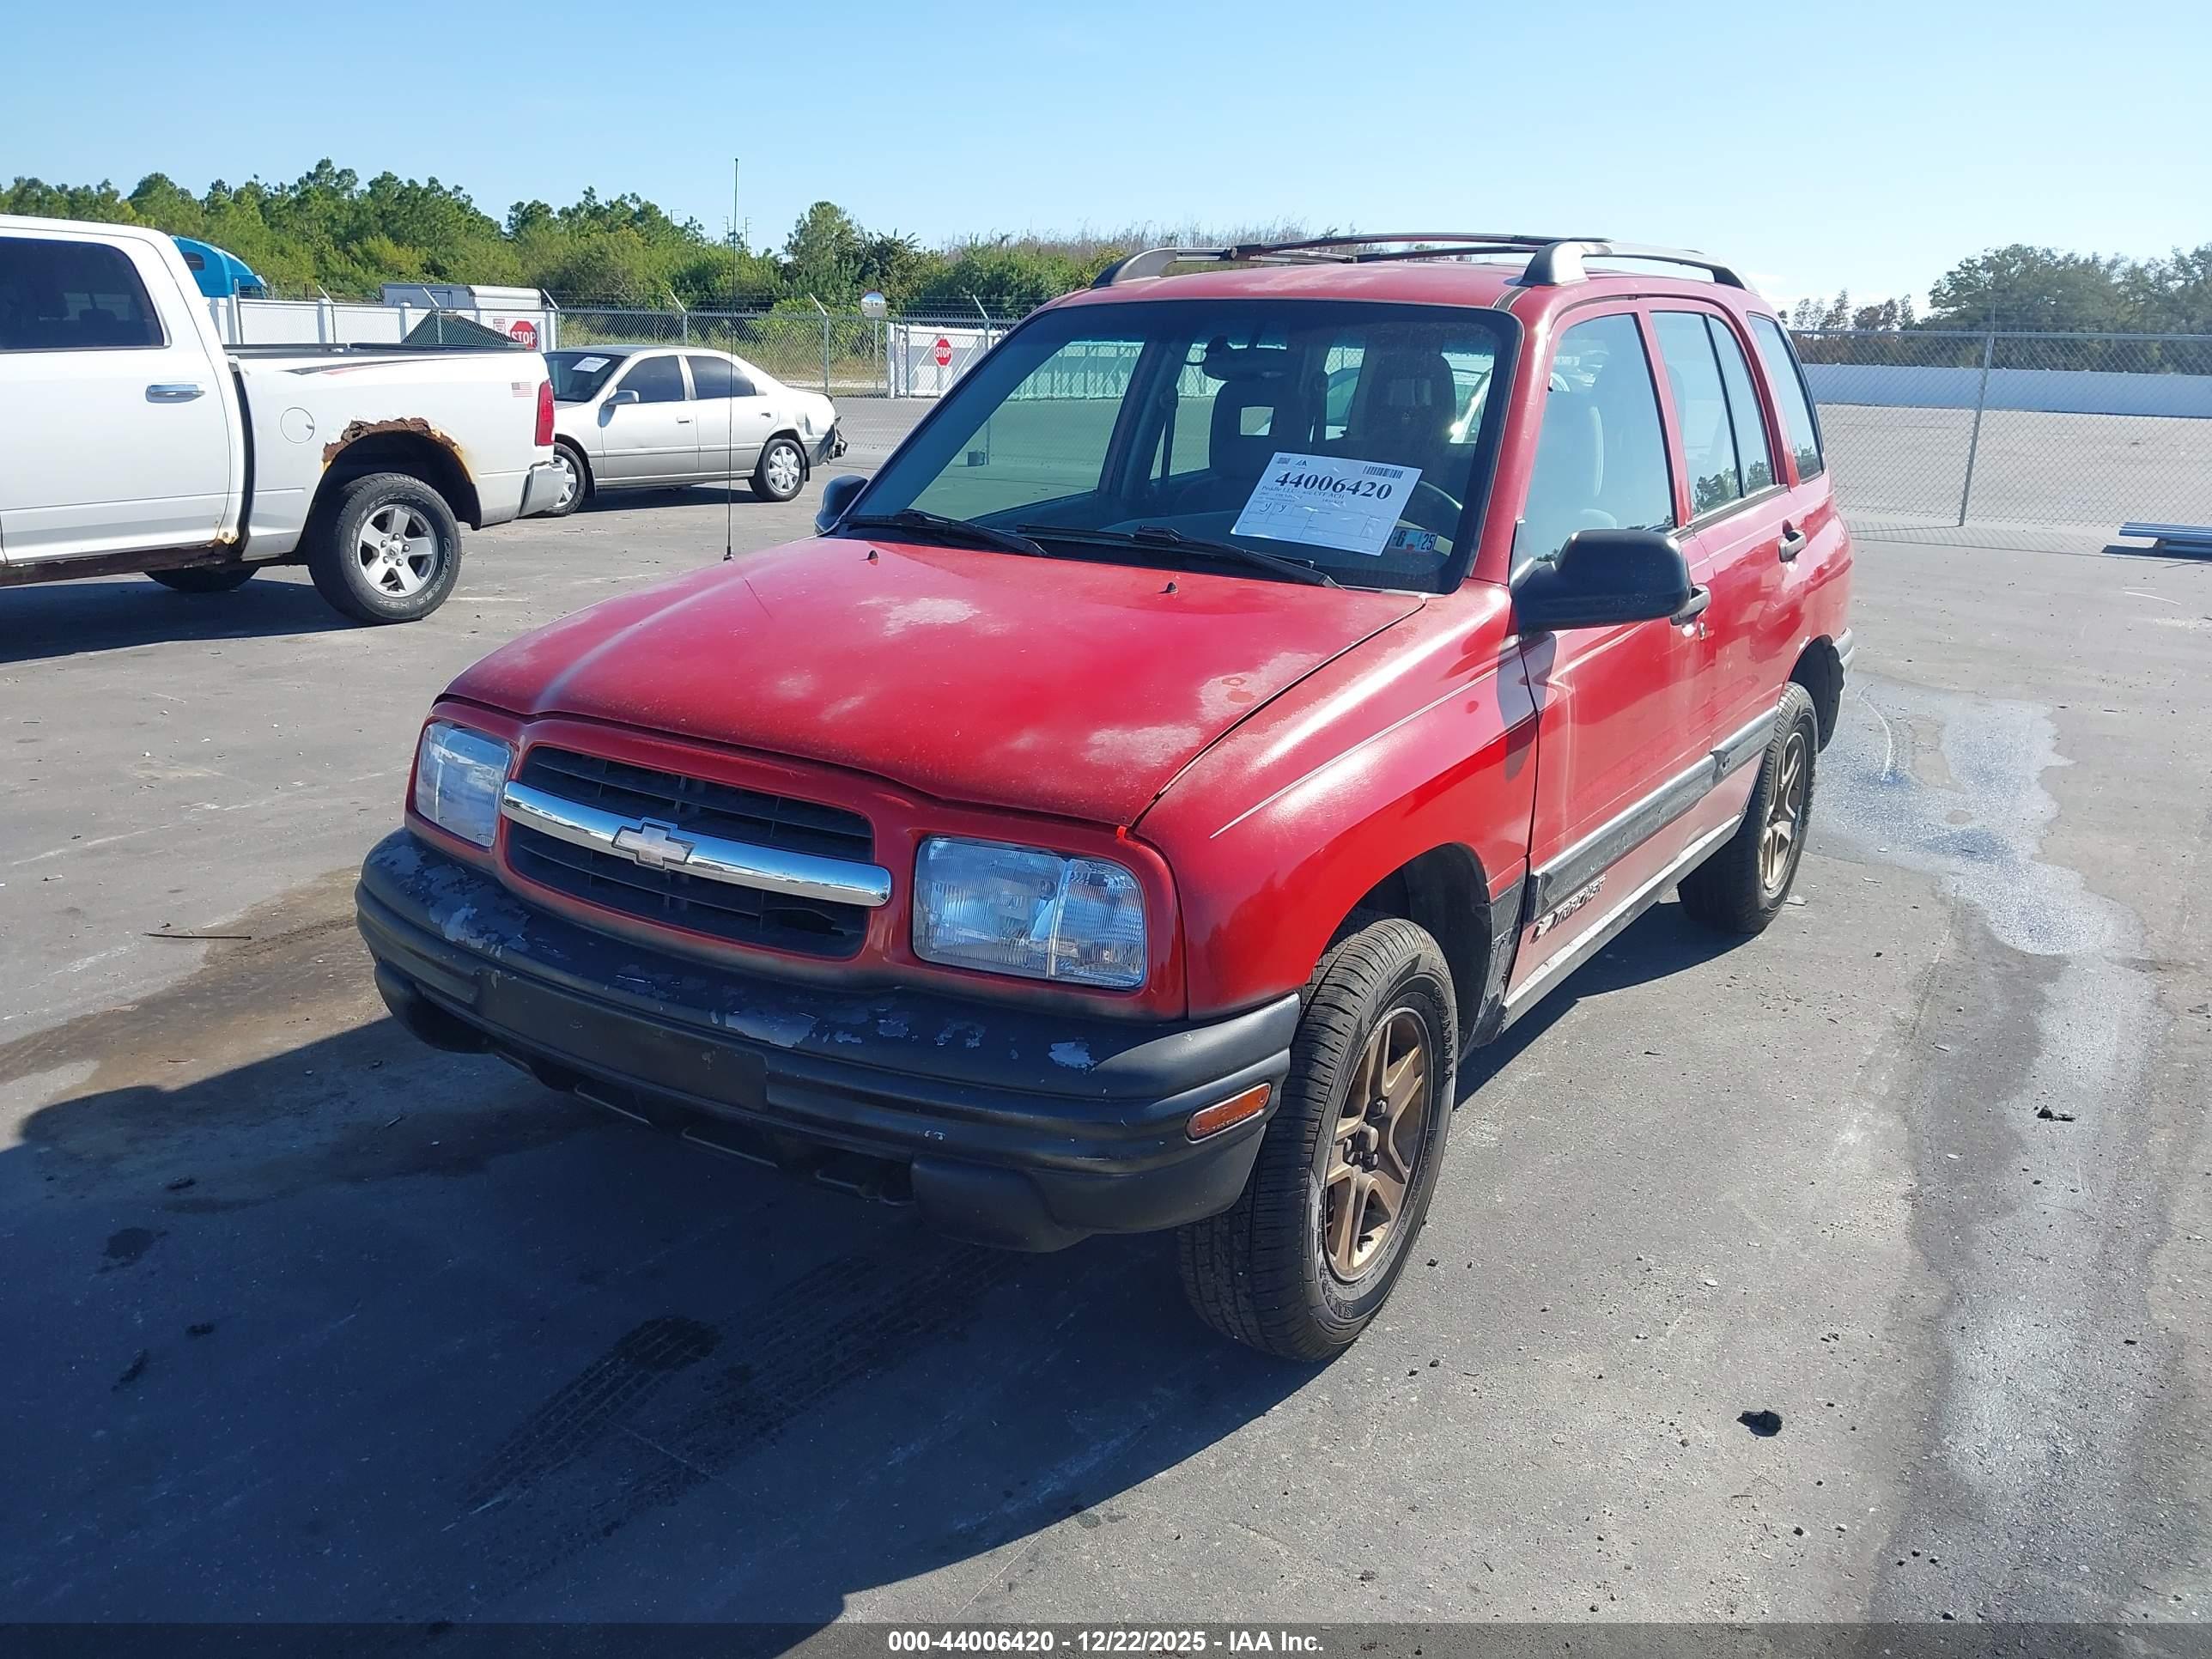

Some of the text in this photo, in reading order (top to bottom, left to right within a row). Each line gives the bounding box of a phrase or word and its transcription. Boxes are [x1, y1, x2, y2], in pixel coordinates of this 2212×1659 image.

[511, 331, 537, 345] STOP
[935, 346, 951, 358] STOP
[1274, 471, 1393, 500] 44006420
[1420, 533, 1436, 550] 25
